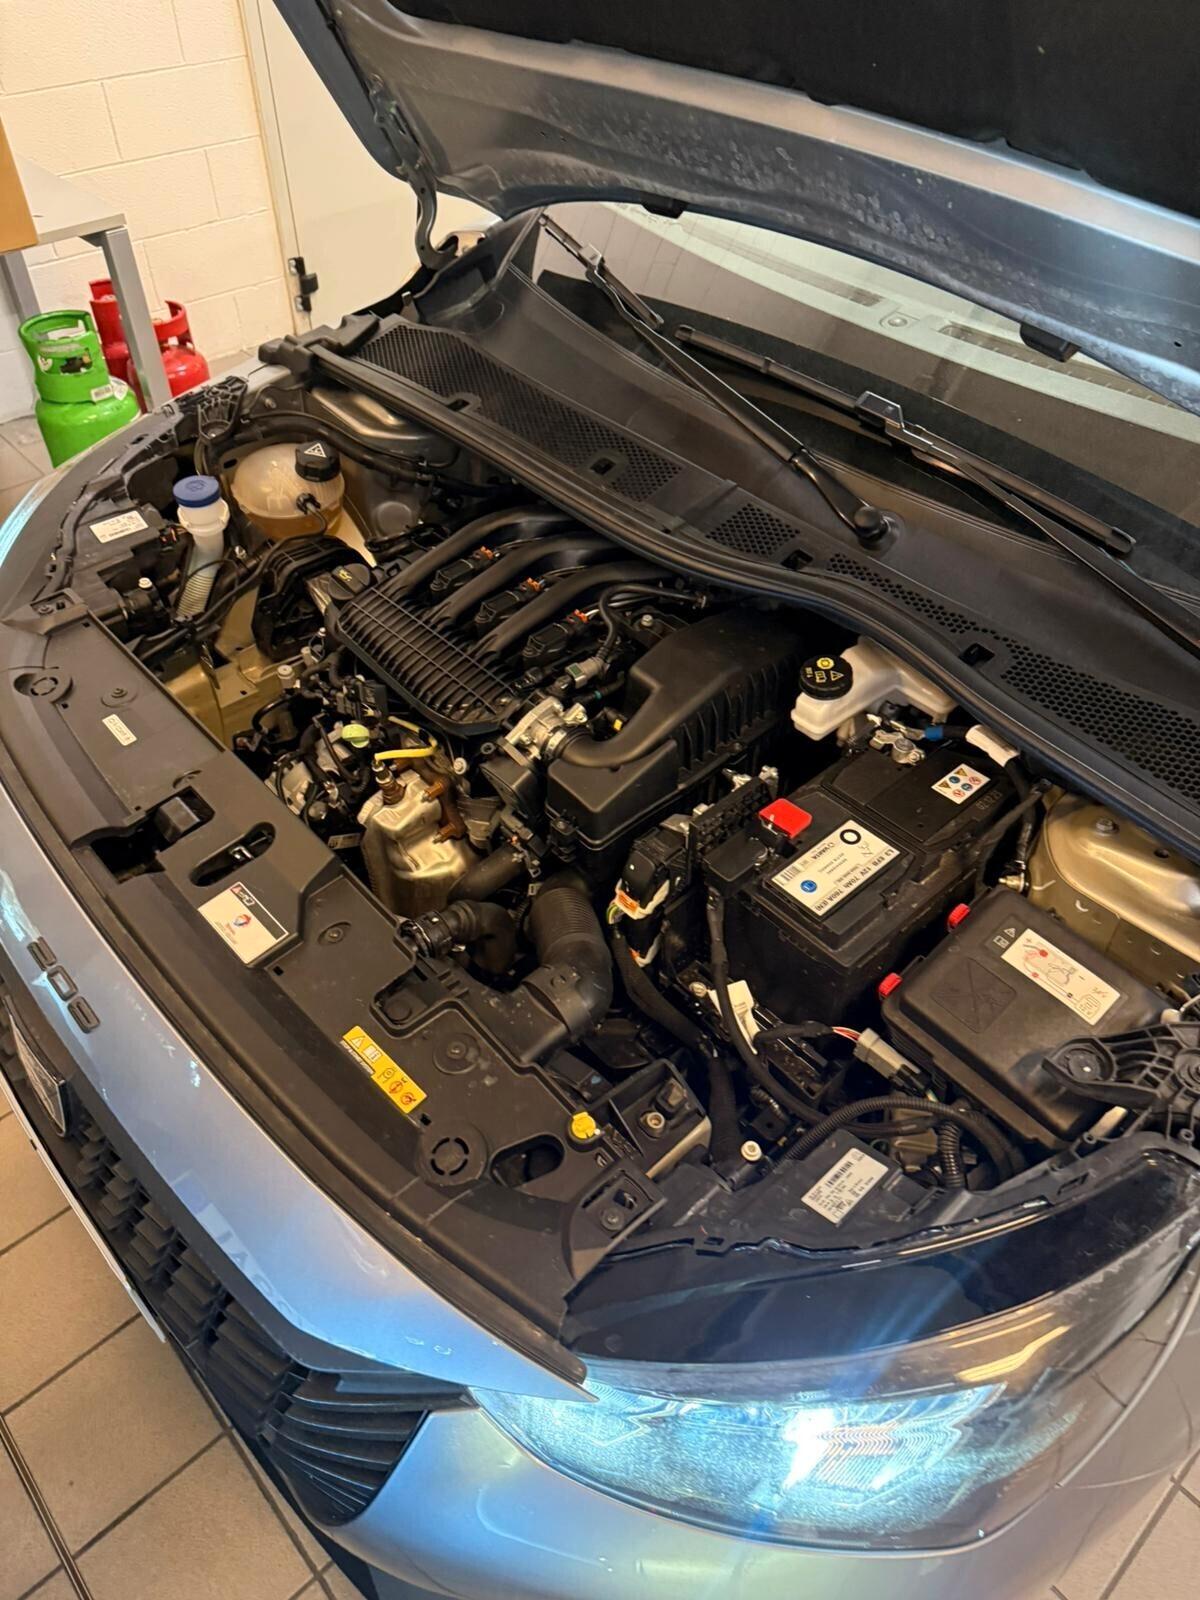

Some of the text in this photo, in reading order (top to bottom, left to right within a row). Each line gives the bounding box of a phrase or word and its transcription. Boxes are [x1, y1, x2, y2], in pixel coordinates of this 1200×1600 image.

[859, 866, 871, 876] 12V
[843, 876, 859, 888] 70Ah
[26, 936, 101, 1034] 208
